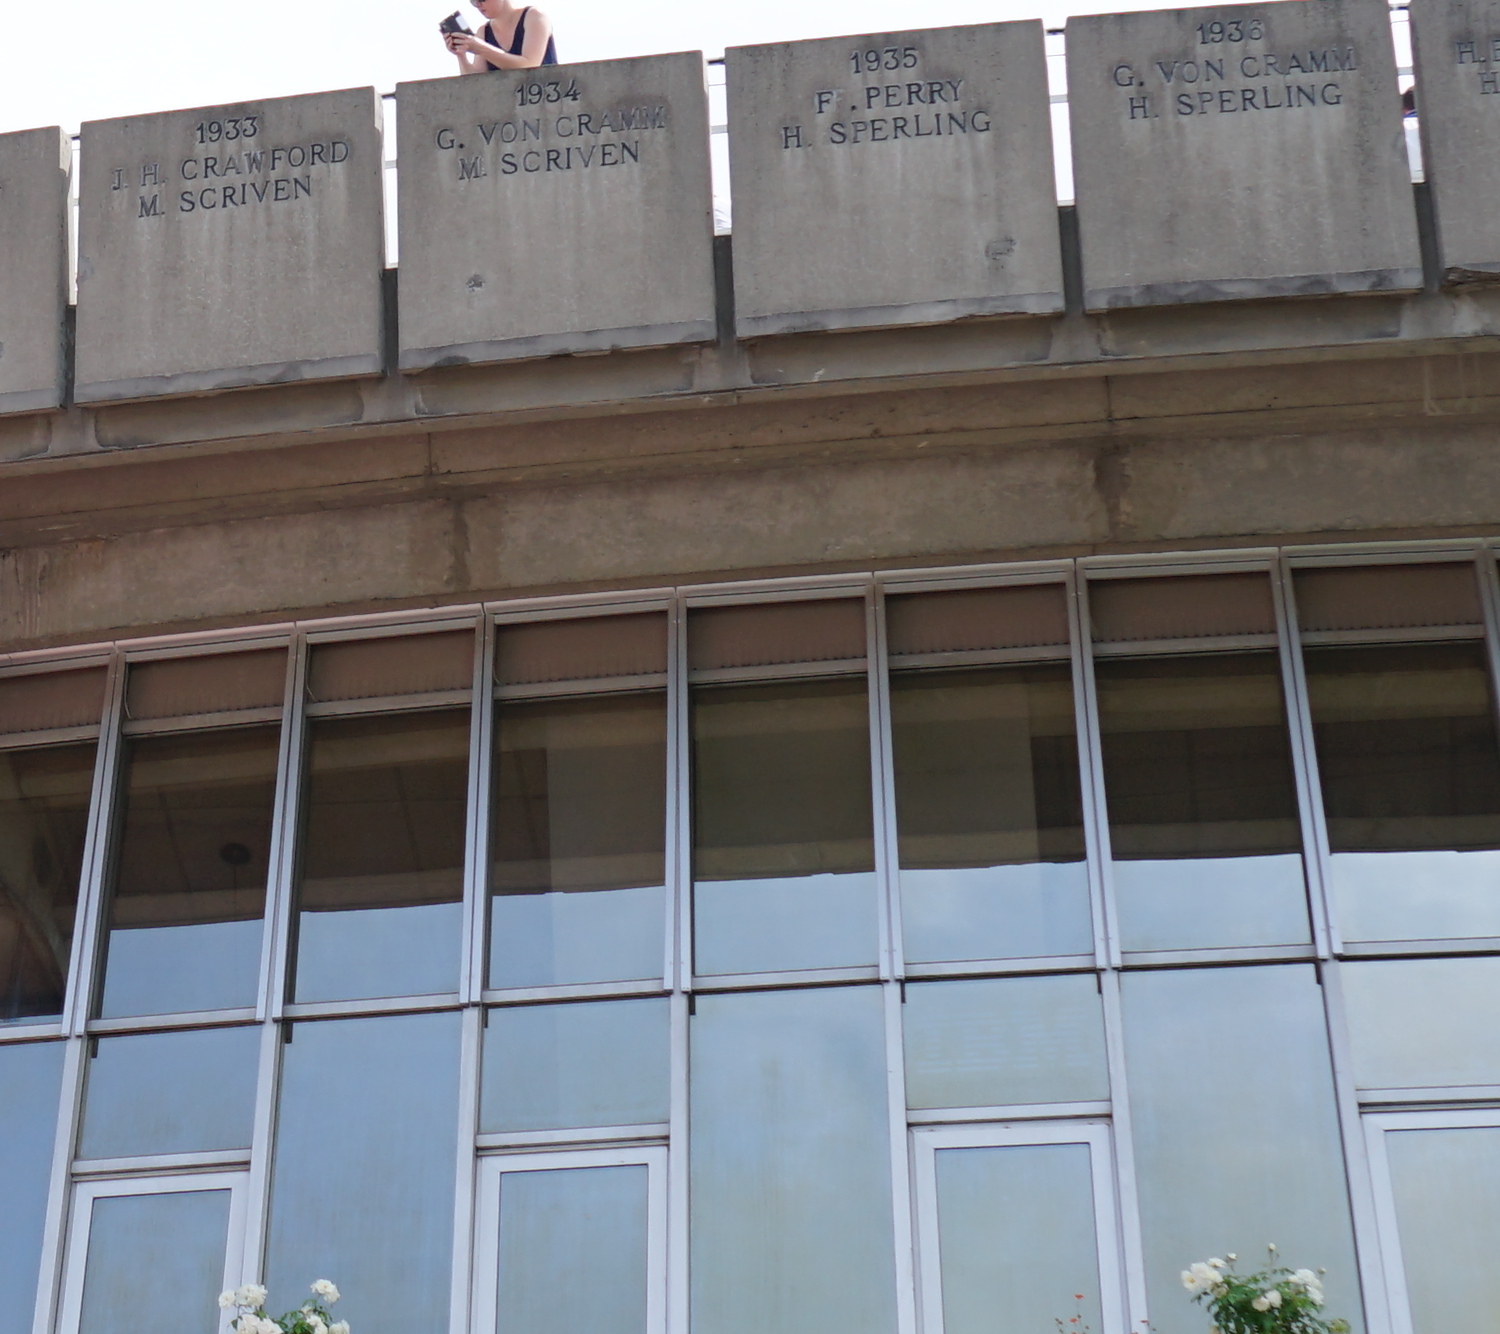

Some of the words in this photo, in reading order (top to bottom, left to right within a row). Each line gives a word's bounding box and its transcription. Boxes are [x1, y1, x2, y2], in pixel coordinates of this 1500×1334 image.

[1196, 18, 1263, 45] 1936
[849, 46, 918, 74] 1935
[1113, 64, 1145, 88] G.
[1157, 57, 1225, 85] VON
[1239, 48, 1357, 79] CRAMM
[515, 81, 582, 106] 1934
[865, 80, 963, 109] PERRY
[1127, 96, 1160, 120] H.
[1176, 82, 1343, 116] SPERLING
[195, 116, 259, 144] 1933
[436, 127, 465, 151] G.
[478, 117, 542, 146] VON
[555, 105, 666, 139] CRAMM
[781, 126, 813, 150] H.
[830, 110, 992, 145] SPERLING
[139, 163, 167, 188] H.
[180, 141, 350, 181] CRAWFORD
[458, 158, 487, 182] M.
[500, 141, 640, 176] SCRIVEN
[138, 194, 166, 219] M.
[179, 175, 312, 214] SCRIVEN
